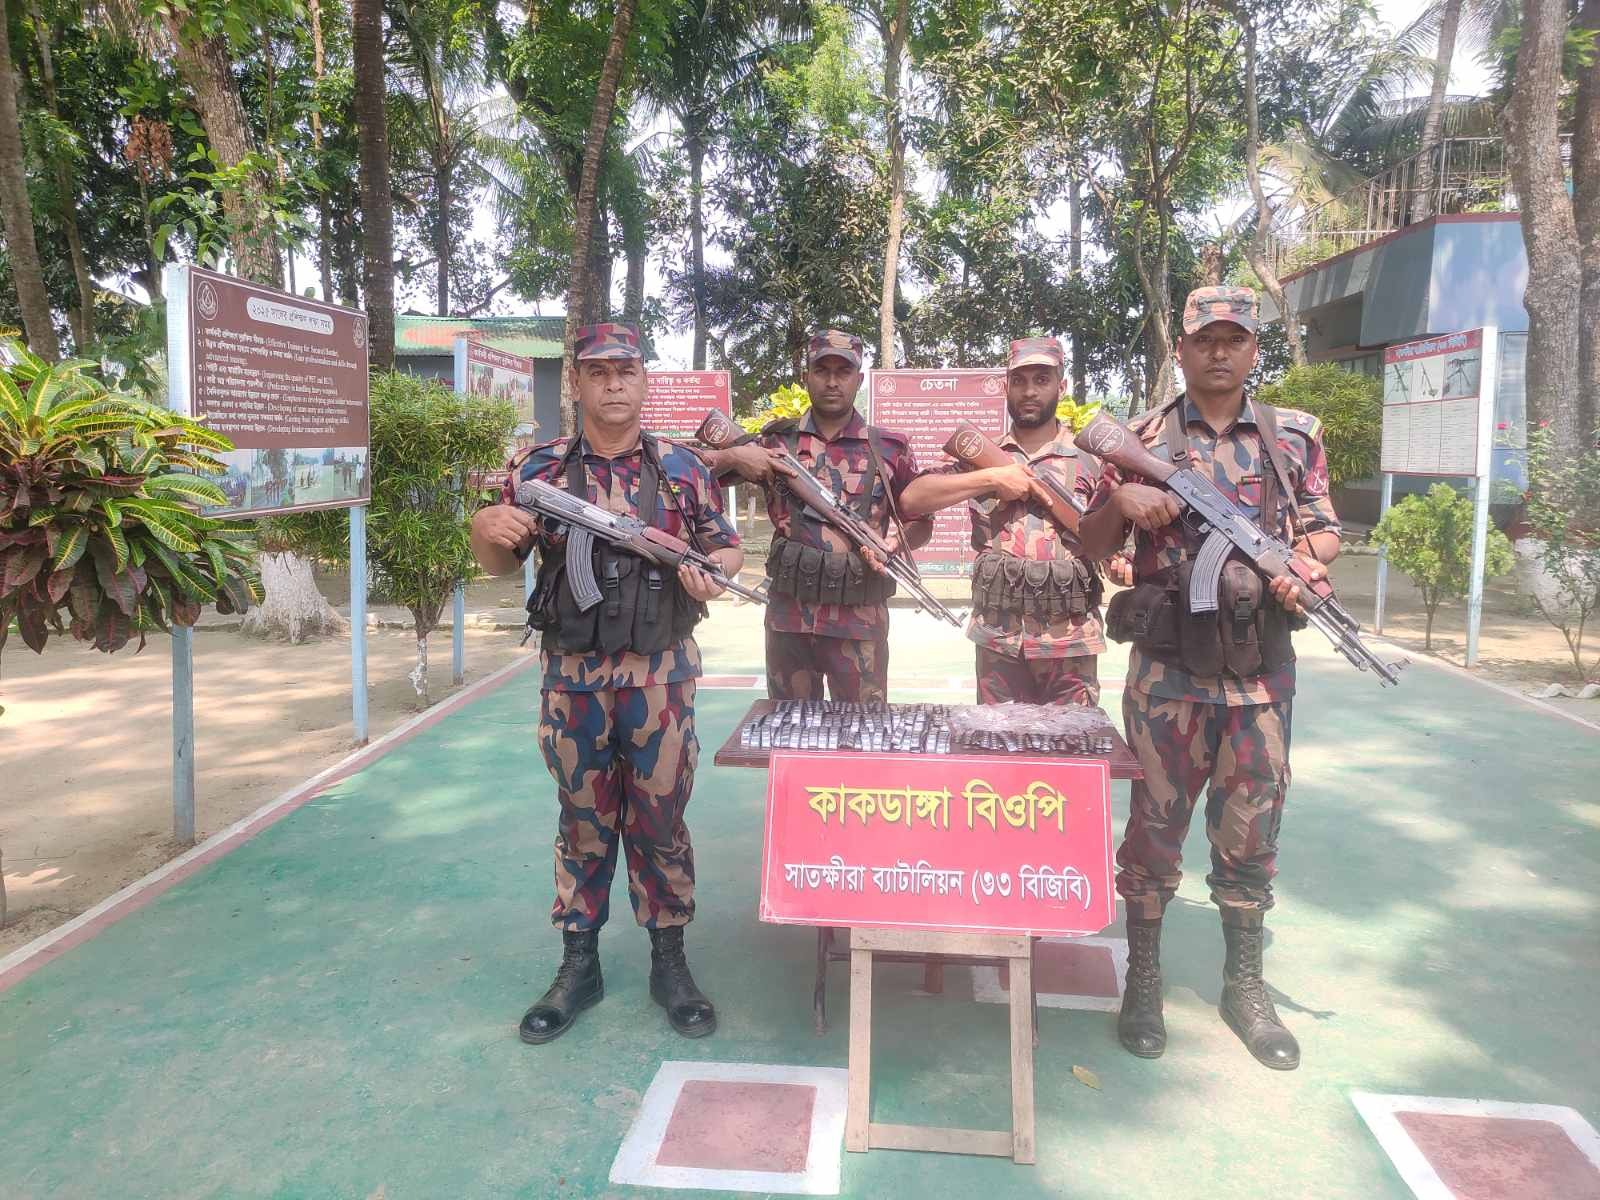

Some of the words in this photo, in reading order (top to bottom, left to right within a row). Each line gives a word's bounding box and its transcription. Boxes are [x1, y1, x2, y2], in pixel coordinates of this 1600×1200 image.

[920, 377, 959, 391] চেতনা
[805, 784, 953, 830] কাকডাঙ্গা
[961, 779, 1067, 833] বিওপি
[784, 855, 866, 893] সাতক্ষীরা
[871, 859, 964, 896] ব্যাটালিয়ন
[1018, 864, 1091, 909] বিজিবি)
